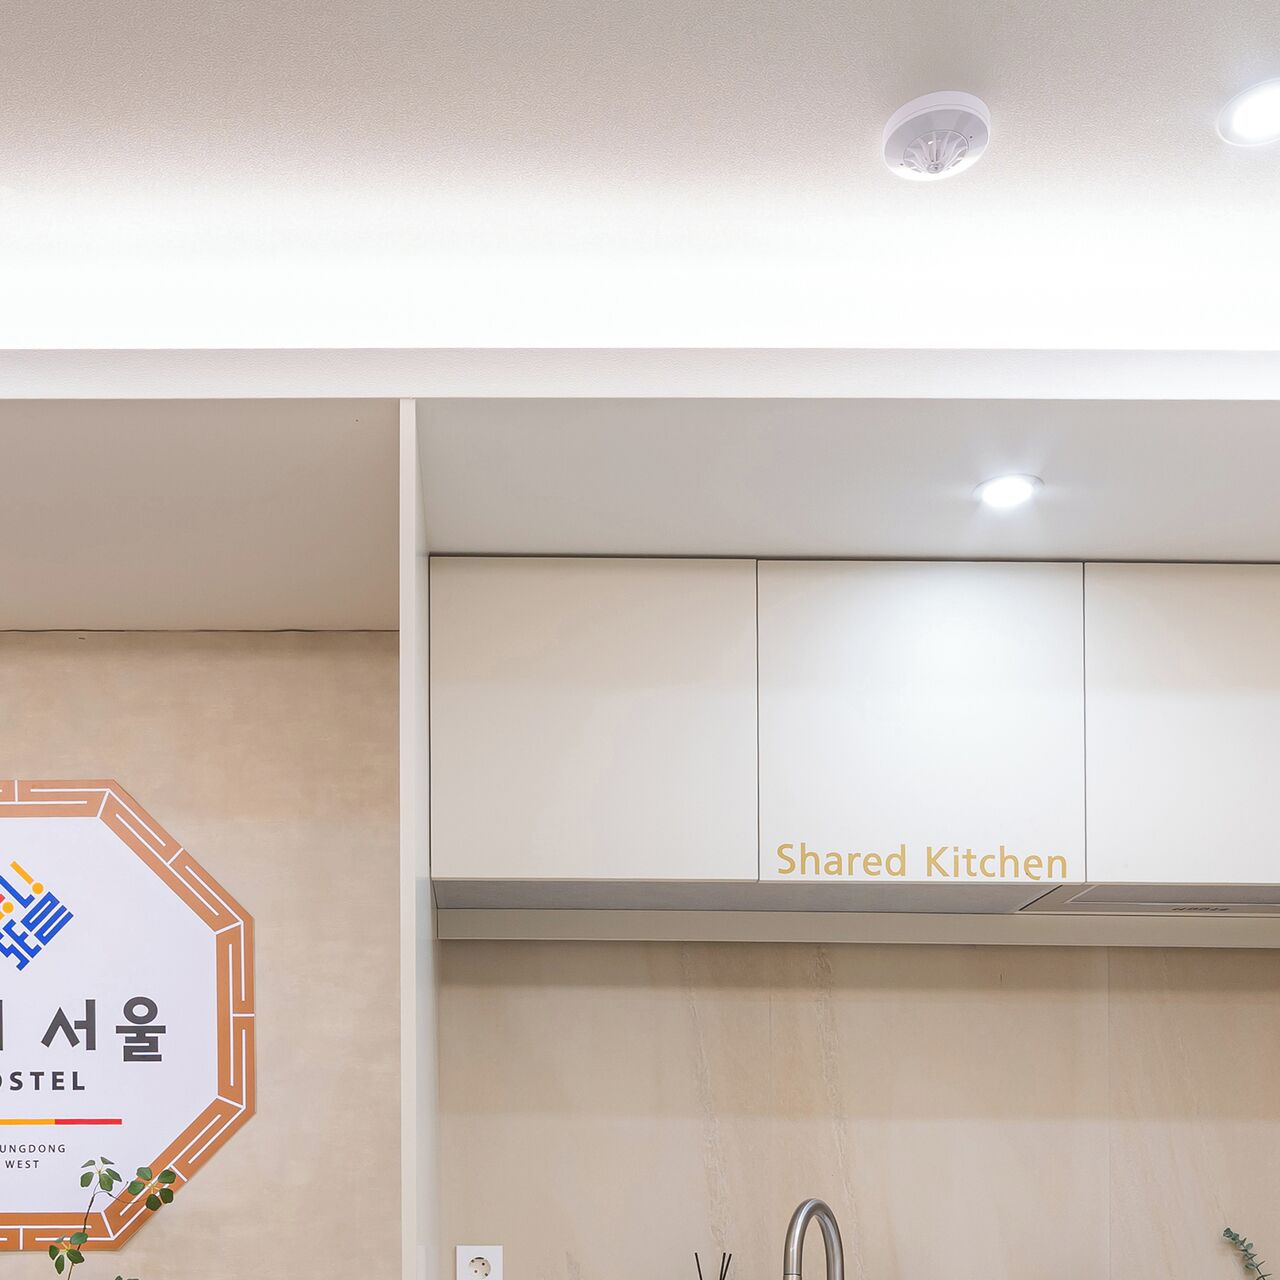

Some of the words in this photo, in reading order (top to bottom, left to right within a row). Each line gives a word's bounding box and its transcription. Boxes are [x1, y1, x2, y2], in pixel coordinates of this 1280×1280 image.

[776, 843, 907, 877] Shared
[926, 845, 1068, 881] Kitchen
[41, 996, 167, 1062] 서울
[4, 1159, 40, 1169] WEST
